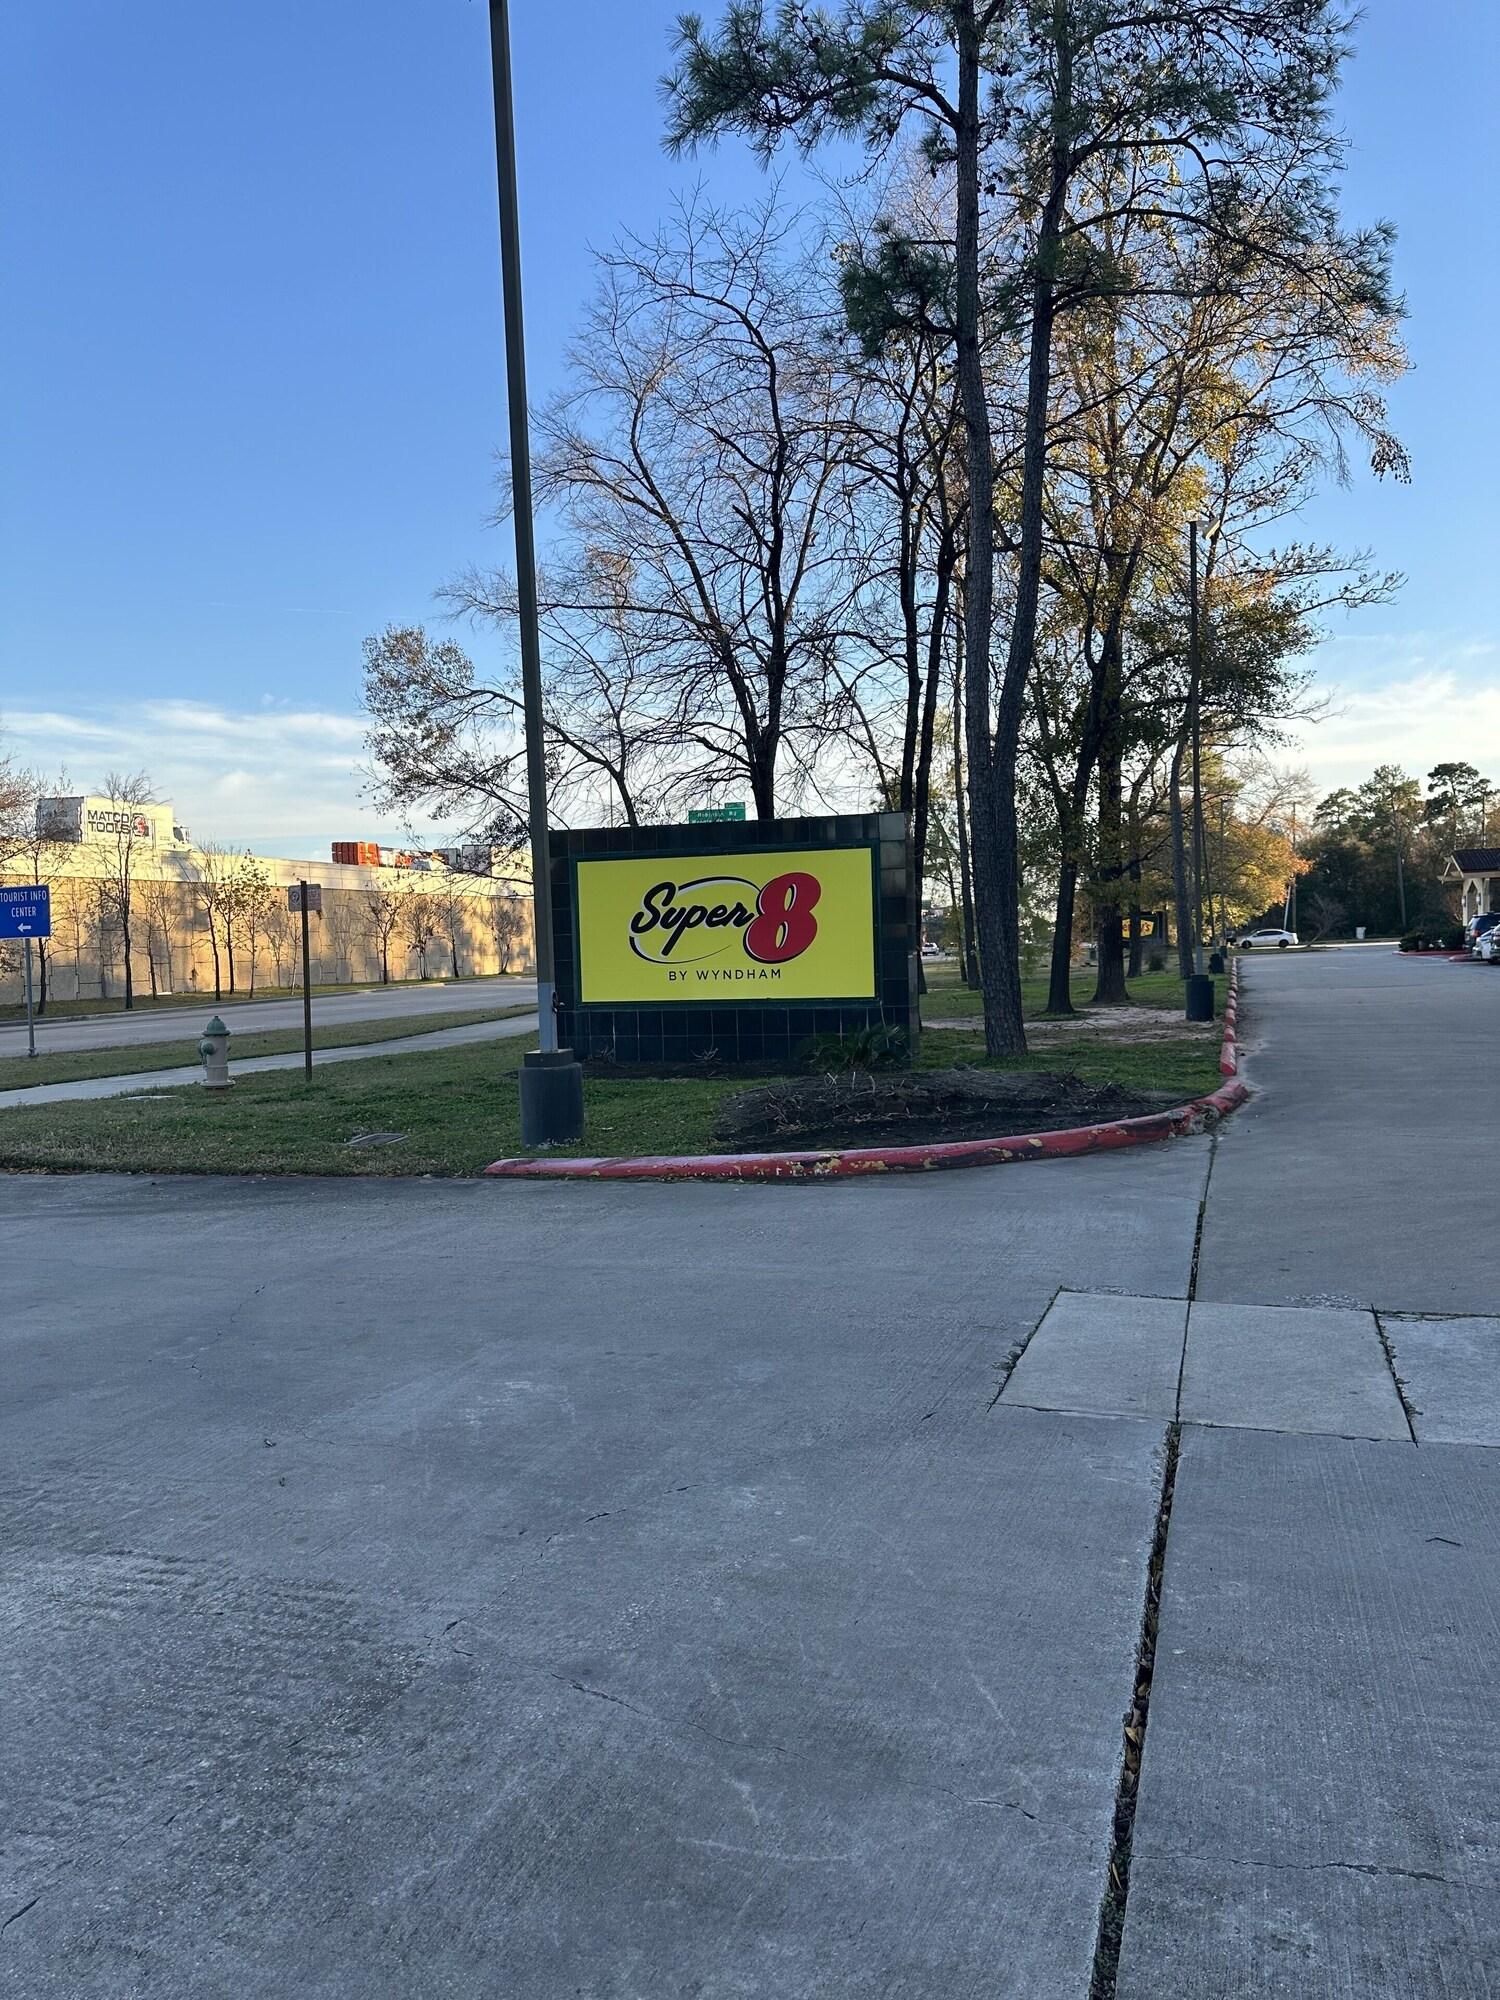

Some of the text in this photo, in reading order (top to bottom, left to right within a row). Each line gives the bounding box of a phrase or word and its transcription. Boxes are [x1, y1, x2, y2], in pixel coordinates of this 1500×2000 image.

[88, 810, 129, 823] MATCO
[88, 821, 131, 834] TOOLS
[0, 890, 47, 903] TOURIST INFO
[11, 906, 37, 918] CENTER
[630, 871, 822, 964] Super 8
[668, 968, 781, 981] BY WYNDHAM
